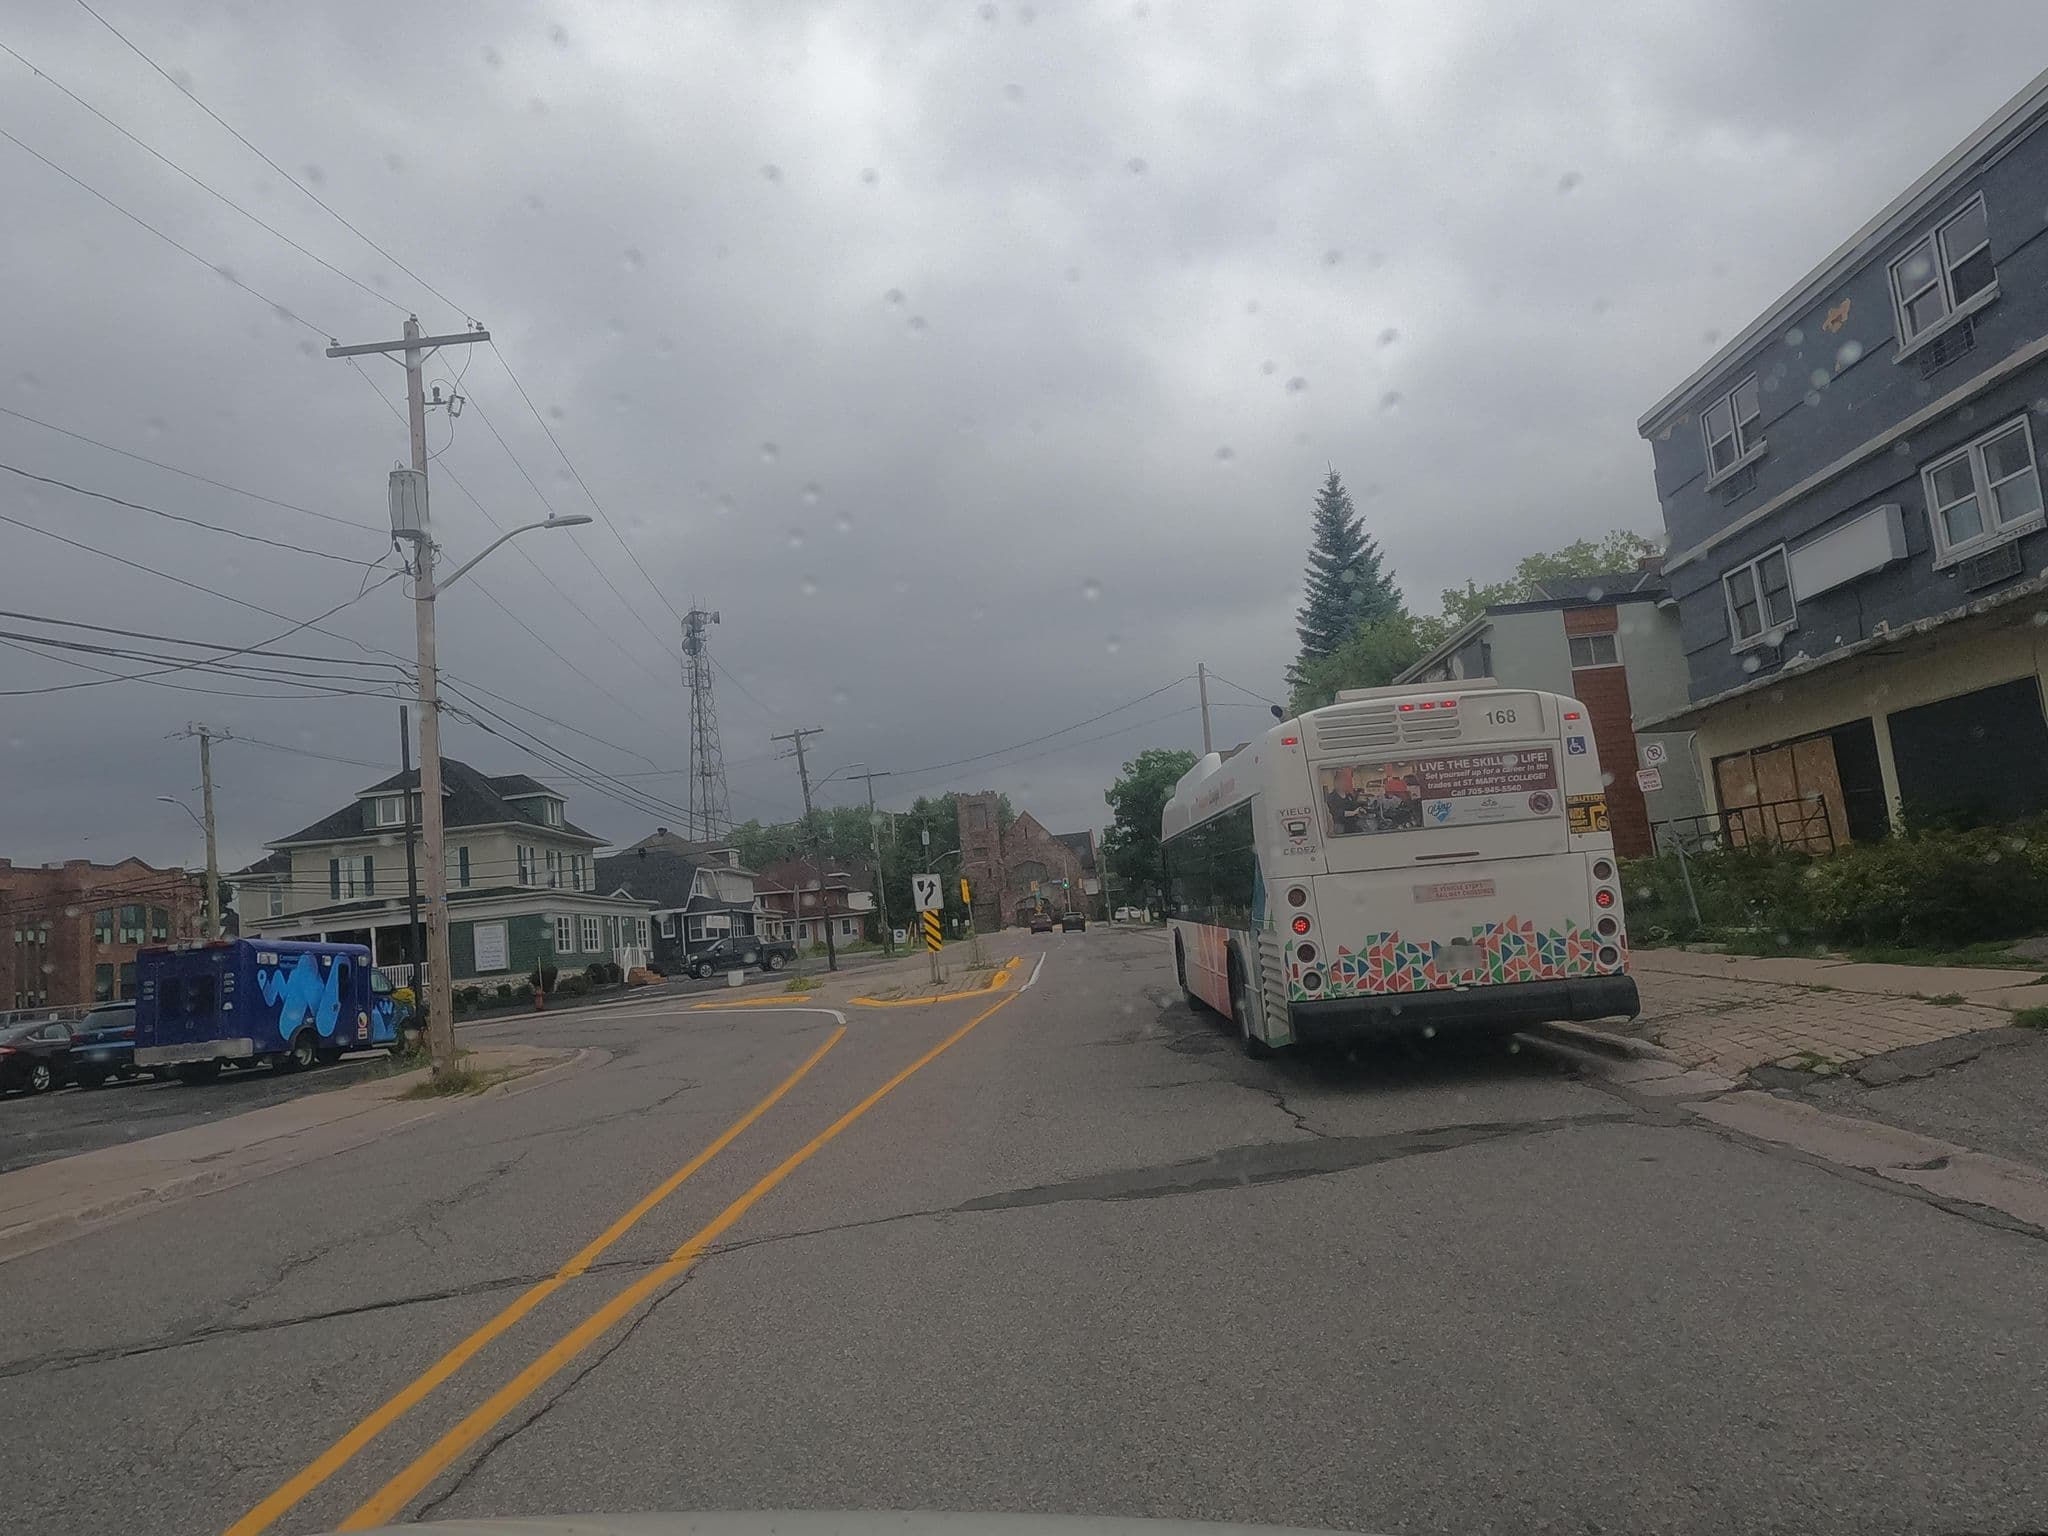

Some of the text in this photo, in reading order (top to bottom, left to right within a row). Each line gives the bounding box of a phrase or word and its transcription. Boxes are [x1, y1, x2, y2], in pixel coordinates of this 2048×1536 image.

[1486, 709, 1517, 725] 168
[1420, 761, 1445, 772] LIVE
[1447, 758, 1470, 769] THE
[1521, 752, 1548, 764] LIFE!
[1425, 771, 1438, 780] Set
[1439, 768, 1470, 780] yourself
[1472, 768, 1481, 777] up
[1483, 765, 1494, 775] for
[1527, 763, 1534, 771] in
[1535, 762, 1549, 770] the
[1428, 772, 1546, 789] trades at ST. MARY'S COLLEGE!
[1451, 784, 1522, 797] Call 705-945-5540
[1279, 807, 1311, 817] YIELD
